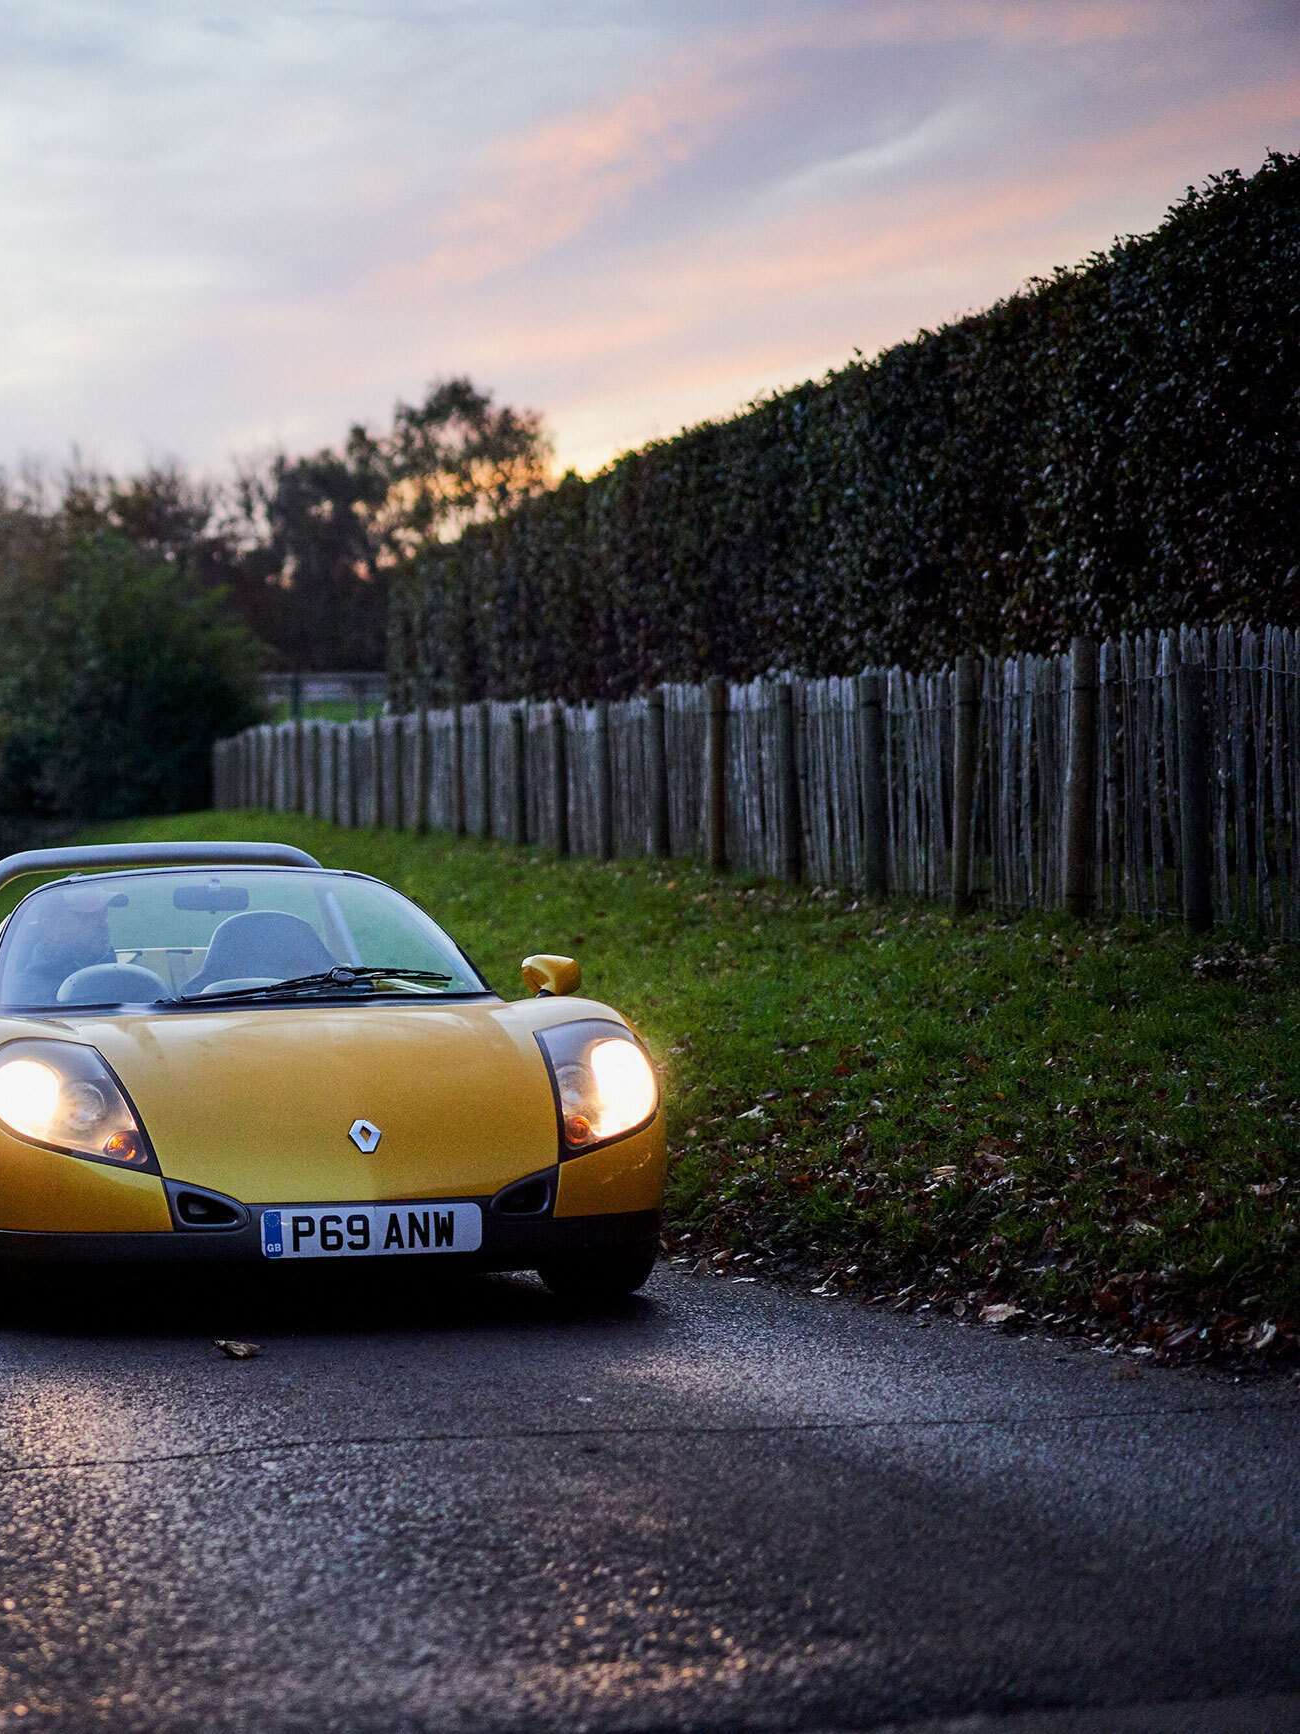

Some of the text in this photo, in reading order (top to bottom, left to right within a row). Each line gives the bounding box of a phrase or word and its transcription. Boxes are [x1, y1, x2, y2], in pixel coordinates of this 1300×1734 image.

[292, 1211, 454, 1252] P69 ANW
[267, 1243, 282, 1252] GB
